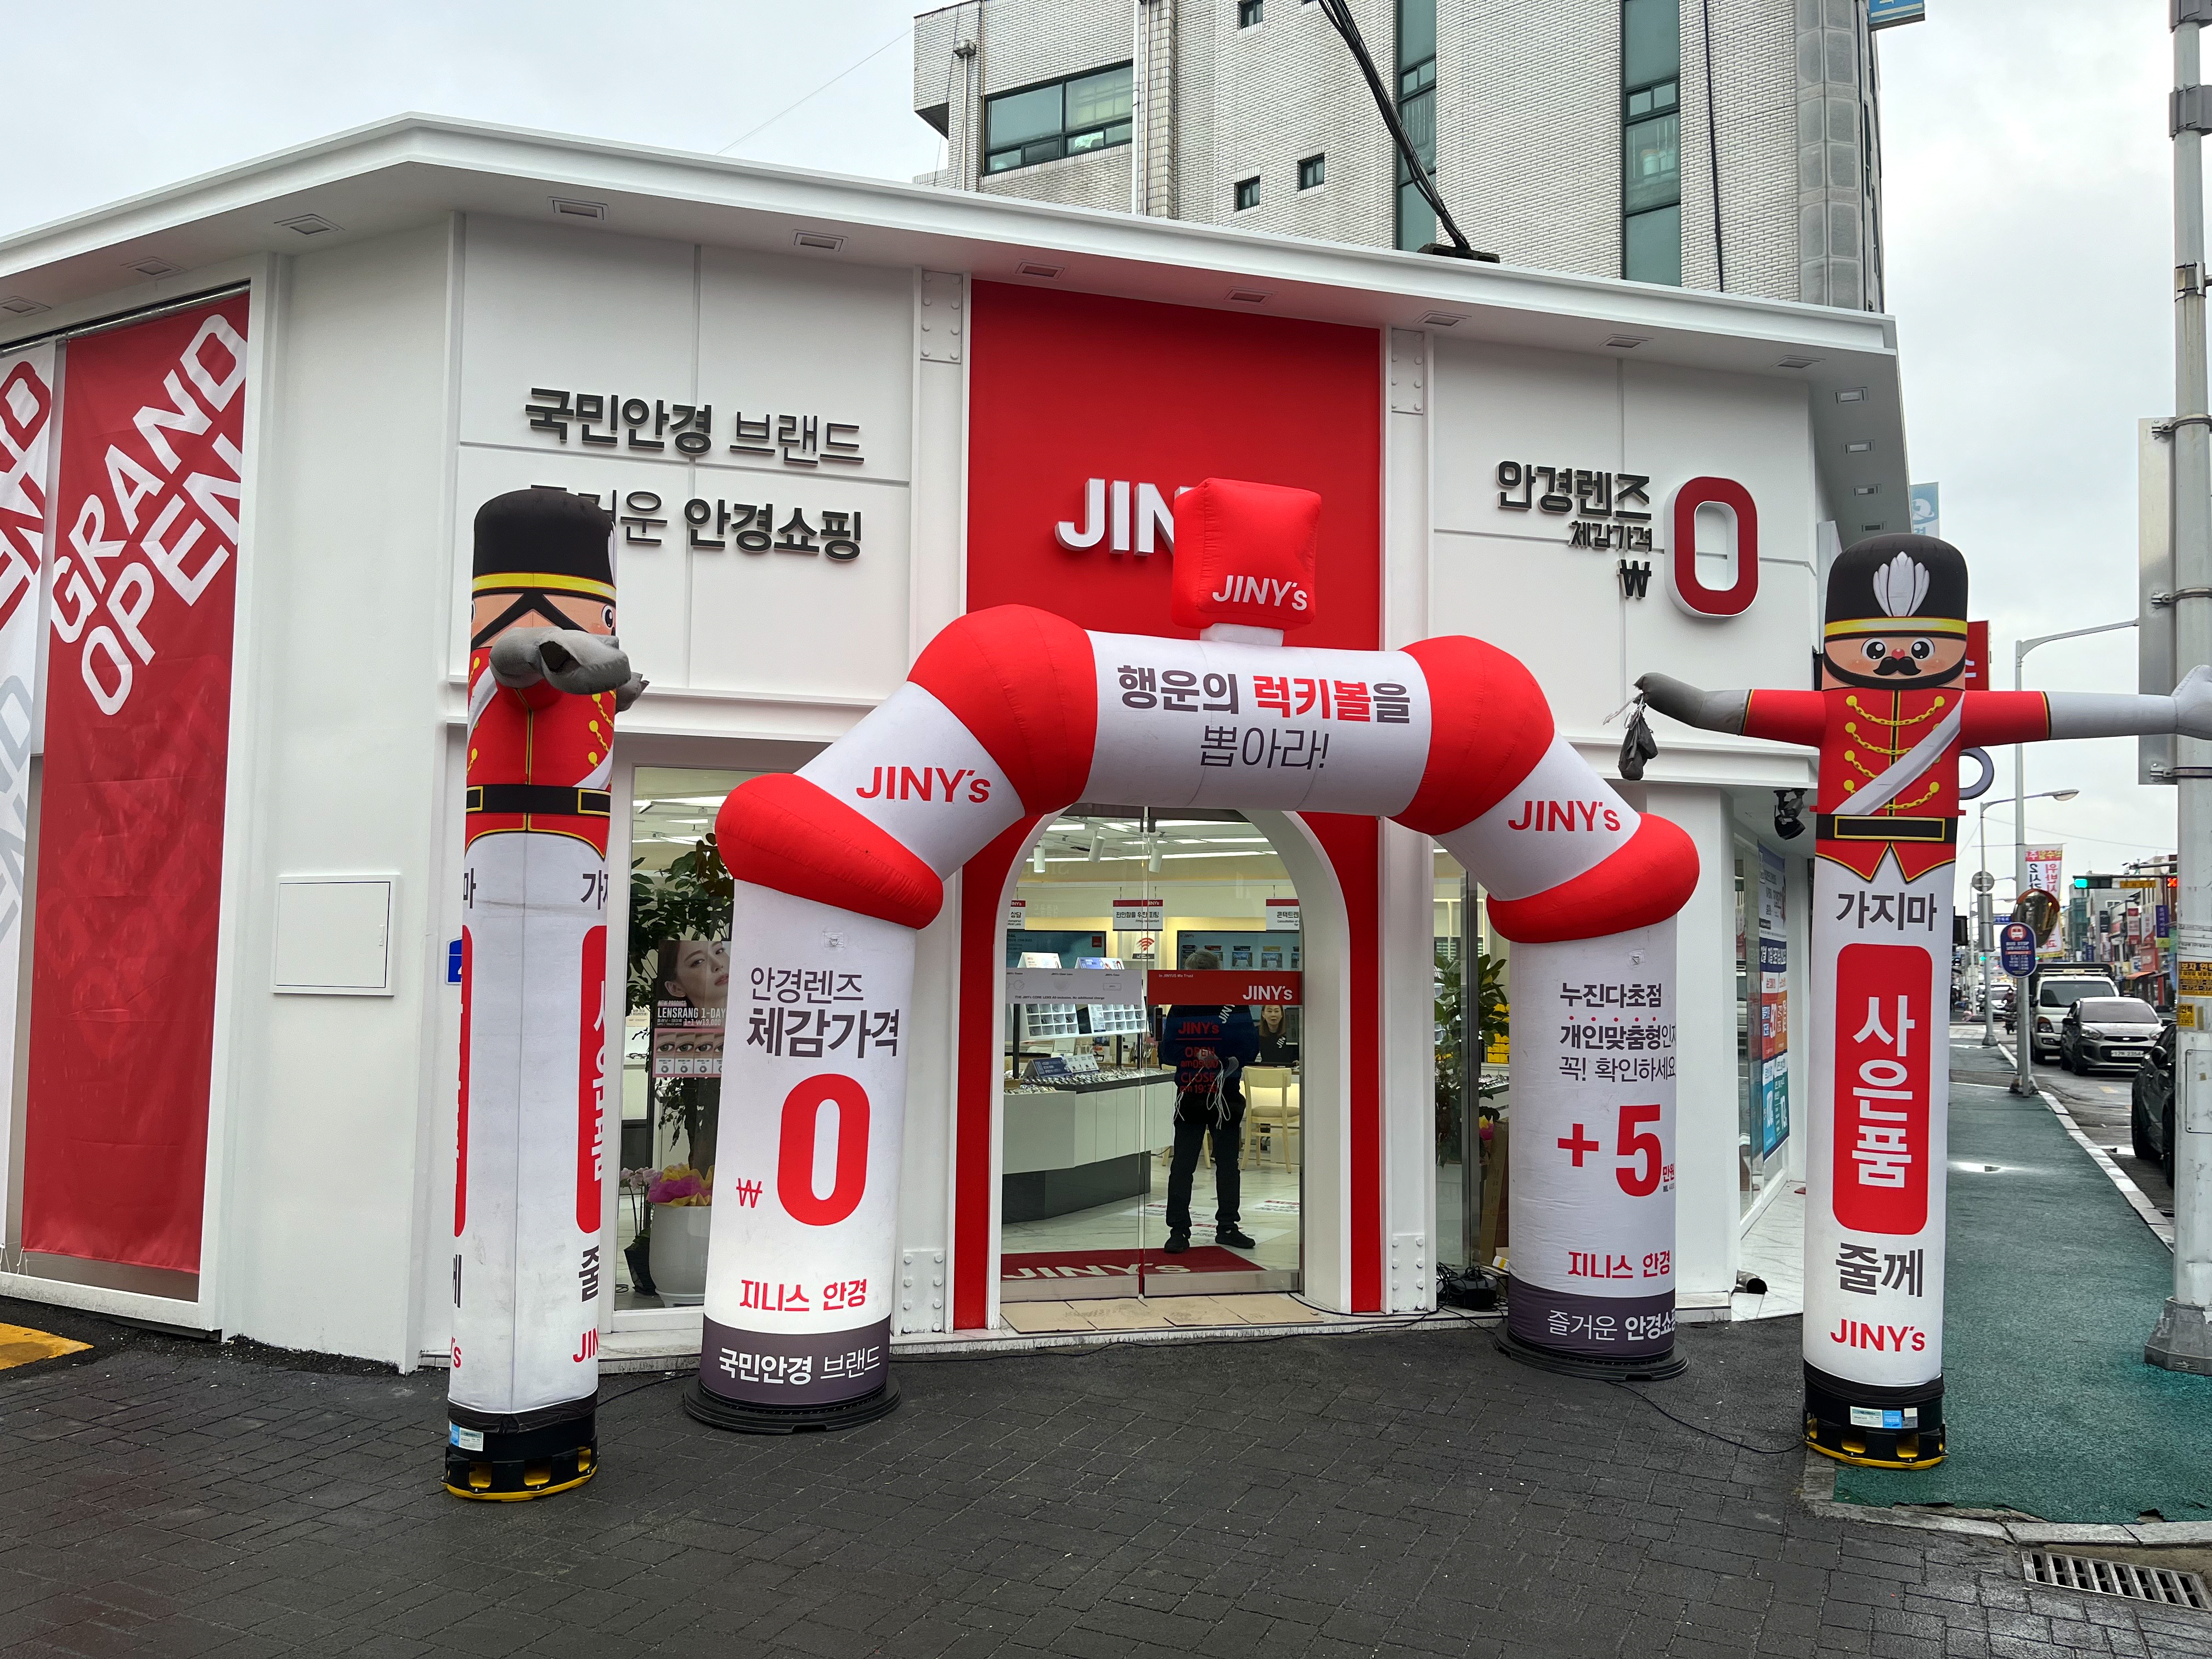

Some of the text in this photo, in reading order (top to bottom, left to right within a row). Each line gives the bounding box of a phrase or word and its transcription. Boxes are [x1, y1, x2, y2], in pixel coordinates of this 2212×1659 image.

[525, 388, 865, 465] 국민안경 브랜드
[51, 314, 247, 643] GRAND
[1496, 461, 1652, 520] 안경렌즈
[685, 498, 862, 561] 안경쇼핑
[1568, 521, 1652, 552] 체감가격
[1667, 476, 1759, 618] 0
[1212, 574, 1307, 611] JINY's
[1117, 664, 1410, 724] 행운의 럭키볼을
[1200, 725, 1329, 770] 뽑아라!
[856, 766, 991, 803] JINY's
[1508, 800, 1620, 832] JINY's
[1836, 890, 1938, 932] 가지마
[751, 967, 864, 1004] 안경렌즈
[1243, 985, 1293, 1000] JINY's
[1560, 983, 1662, 1008] 누진다초점
[658, 1007, 698, 1018] LENSRANG
[701, 1008, 726, 1019] 1-DAY
[1178, 1022, 1220, 1034] JINY's
[747, 1007, 899, 1058] 체감가격
[1185, 1047, 1215, 1058] OPEN
[1559, 1056, 1587, 1081] 꼭!
[1181, 1072, 1216, 1083] CLOSE
[1852, 994, 1915, 1188] 사은품
[777, 1073, 870, 1226] 0
[1567, 1250, 1671, 1279] 지니스 안경
[1835, 1242, 1923, 1297] 줄께
[740, 1278, 867, 1312] 지니스 안경
[1547, 1309, 1618, 1340] 즐거운
[1830, 1318, 1926, 1352] JINY's
[719, 1346, 881, 1385] 국민안경 브랜드
